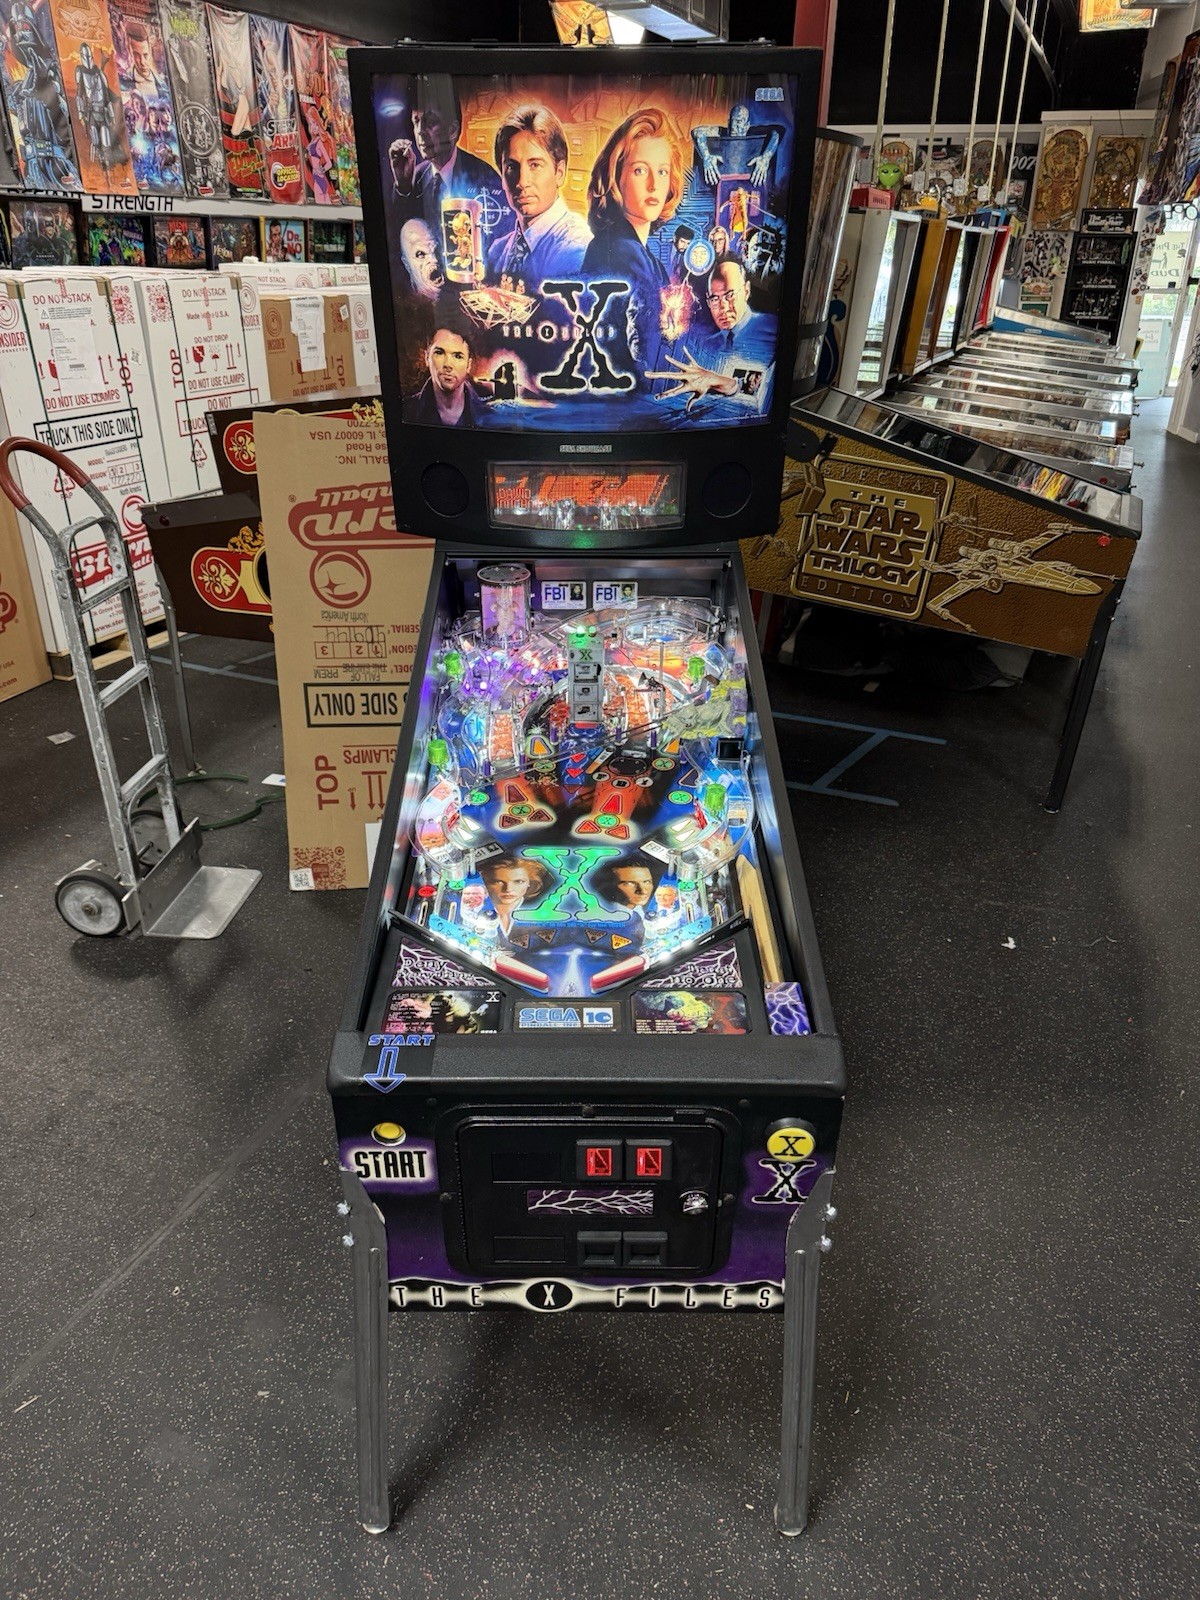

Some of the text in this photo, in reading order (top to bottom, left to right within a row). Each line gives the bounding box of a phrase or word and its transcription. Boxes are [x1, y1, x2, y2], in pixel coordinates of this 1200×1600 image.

[755, 87, 784, 101] SEGA
[1012, 156, 1037, 170] 007
[92, 194, 173, 211] STRENGTH
[286, 244, 302, 254] NO
[33, 295, 45, 305] DO
[67, 293, 92, 303] STACK
[182, 289, 191, 298] DO
[117, 353, 134, 393] TOP
[170, 349, 184, 388] TOP
[337, 355, 345, 387] TOP
[188, 373, 245, 390] DO NOT USE CLAMPS
[45, 398, 57, 410] DO
[58, 396, 73, 407] NOT
[75, 394, 91, 406] USE
[208, 397, 232, 411] DO NOT
[72, 423, 94, 442] THIS
[95, 421, 115, 439] SIDE
[309, 431, 332, 440] USA
[335, 431, 364, 440] 60007
[367, 431, 376, 440] IL
[346, 443, 372, 452] Road
[335, 455, 356, 465] INC.
[823, 464, 940, 495] SPECIAL
[850, 491, 908, 508] THE
[816, 499, 929, 541] STAR
[816, 524, 926, 568] WARS
[809, 551, 920, 588] TRILOGY
[545, 587, 565, 600] FBI
[596, 587, 616, 600] FBI
[801, 576, 914, 608] EDITION
[320, 646, 328, 655] 3
[356, 646, 363, 654] 2
[314, 669, 338, 679] PREM
[314, 692, 355, 716] ONLY
[361, 692, 398, 716] SIDE
[343, 749, 397, 764] CLAMPS
[314, 755, 340, 810] TOP
[512, 848, 632, 922] X
[485, 991, 500, 1003] X
[520, 1007, 580, 1022] SEGA
[368, 1034, 436, 1046] START
[775, 1135, 806, 1157] X
[354, 1150, 428, 1179] START
[752, 1160, 817, 1205] X
[394, 1284, 770, 1308] THE X FILES
